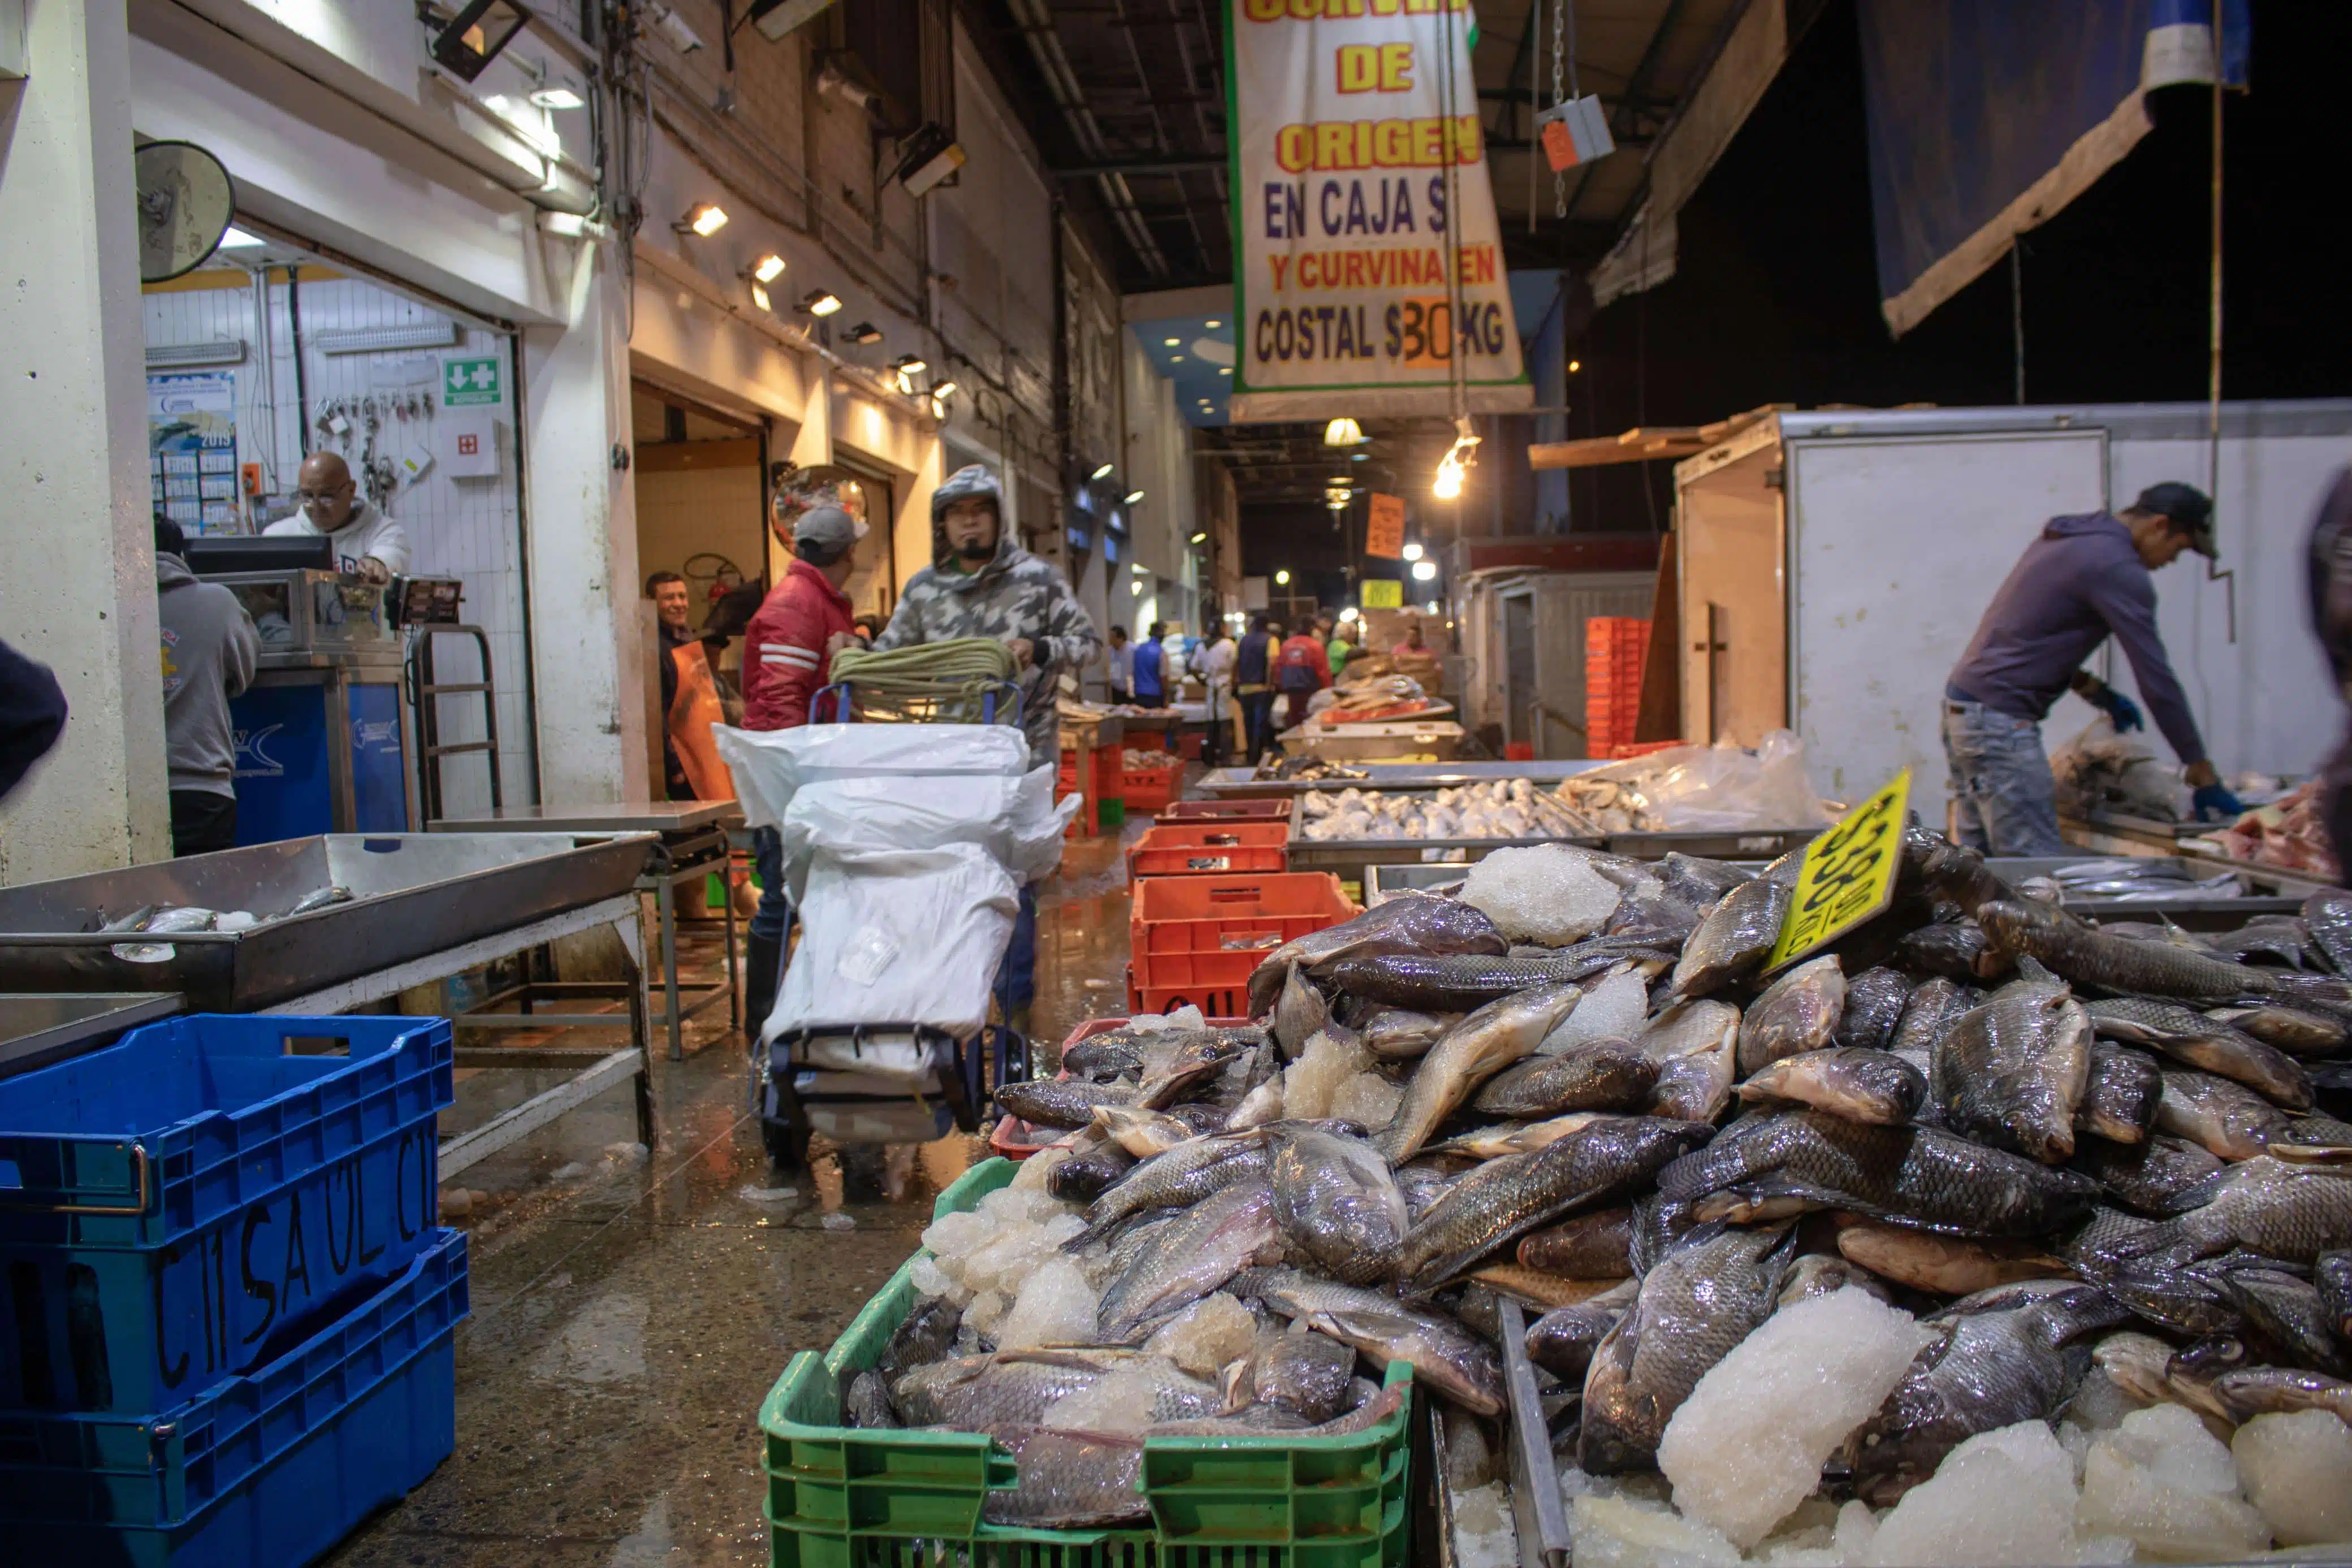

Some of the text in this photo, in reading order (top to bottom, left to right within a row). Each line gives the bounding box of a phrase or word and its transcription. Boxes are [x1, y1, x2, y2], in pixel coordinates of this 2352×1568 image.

[1336, 42, 1415, 95] DE
[1276, 115, 1482, 174] ORIGEN
[1264, 181, 1306, 239] EN
[1320, 177, 1416, 236] CAJA
[1268, 245, 1495, 293] Y CURVINA EN
[1256, 306, 1375, 363] COSTAL
[1460, 300, 1504, 356] KG
[202, 430, 230, 448] 2019
